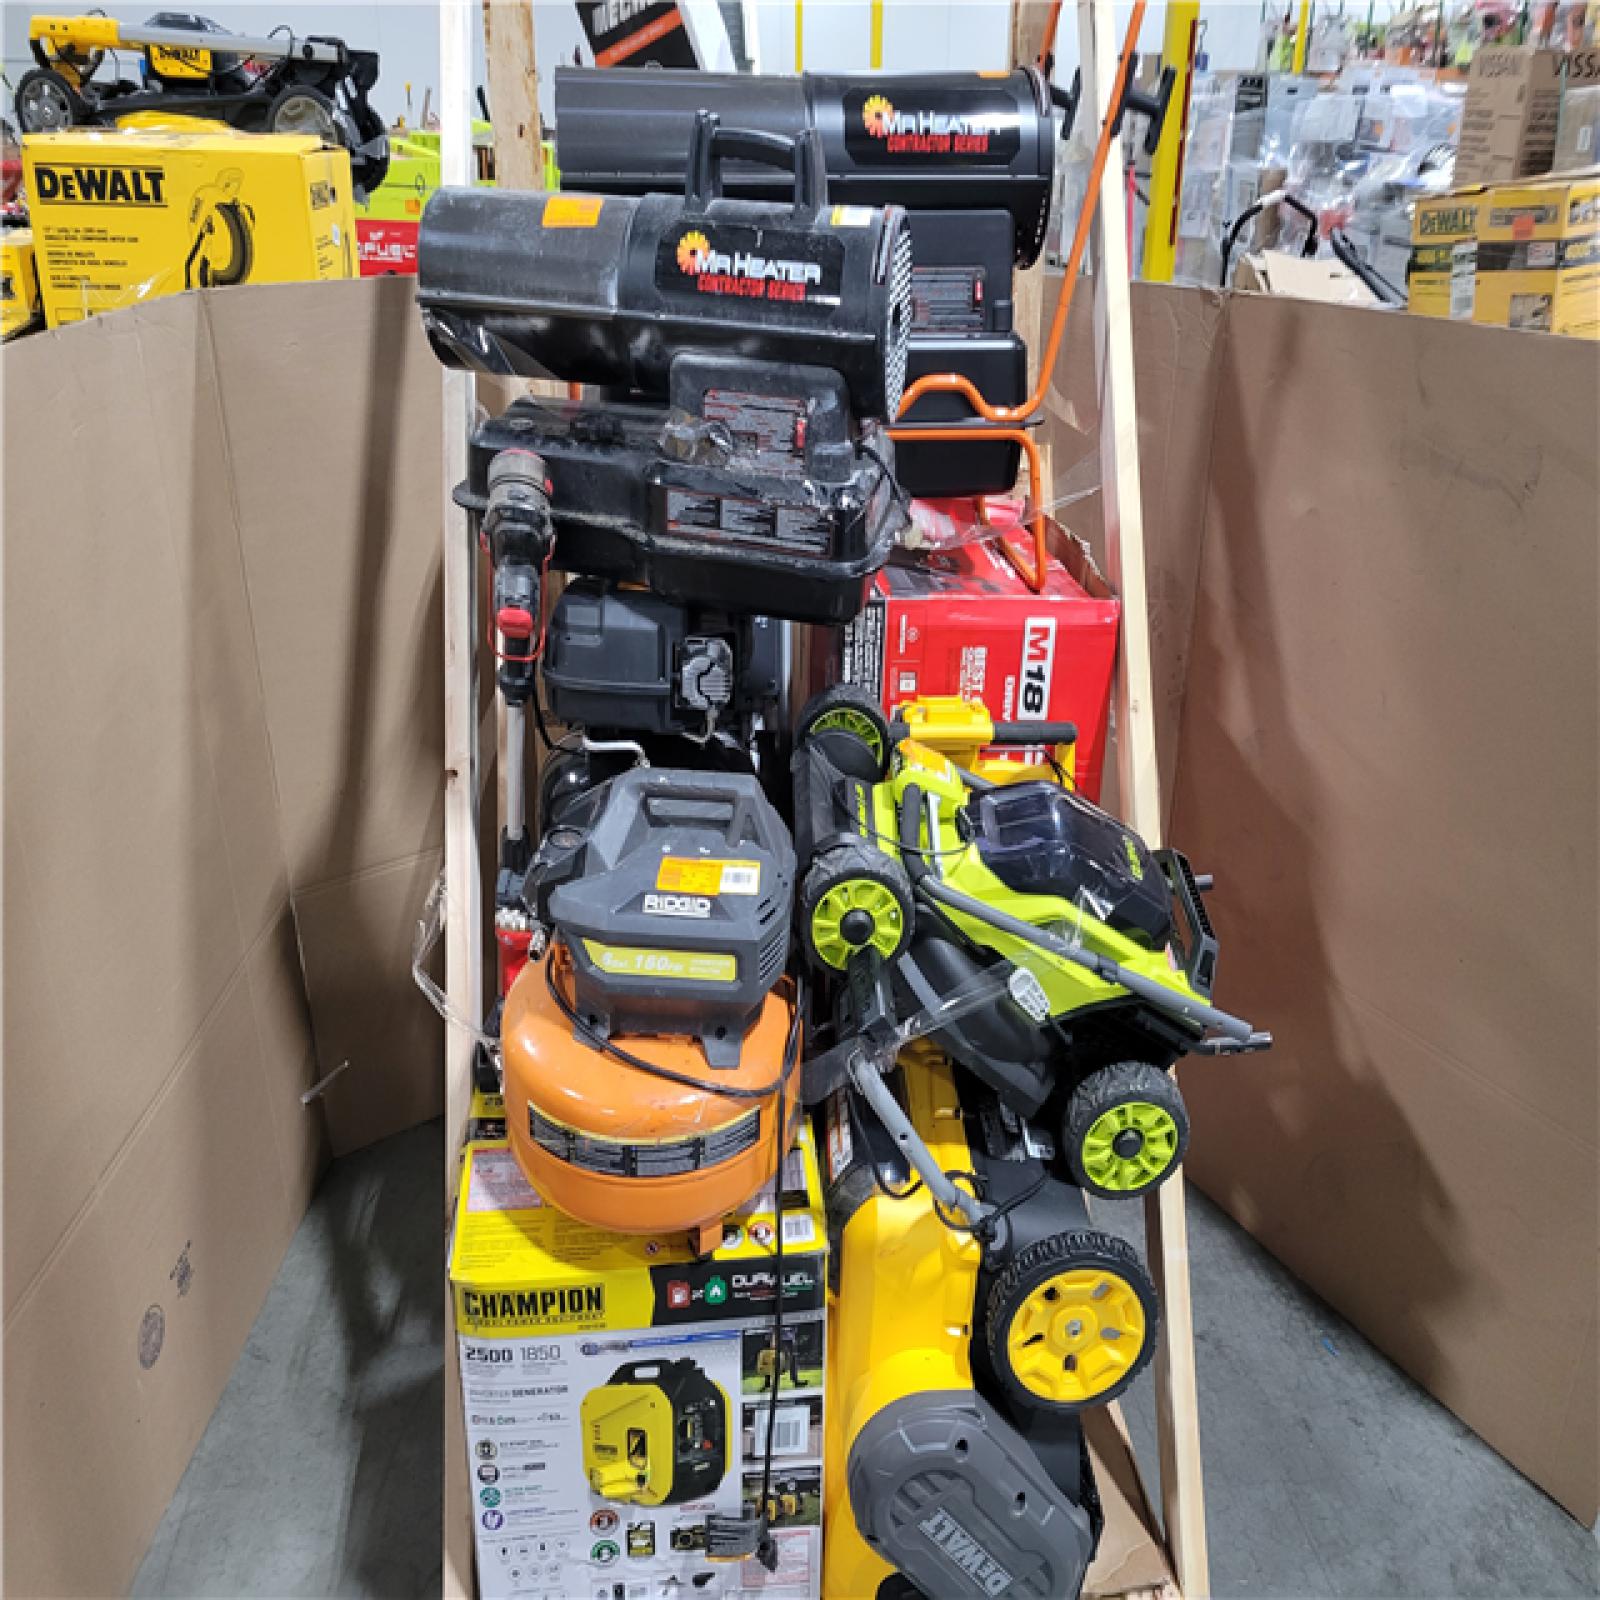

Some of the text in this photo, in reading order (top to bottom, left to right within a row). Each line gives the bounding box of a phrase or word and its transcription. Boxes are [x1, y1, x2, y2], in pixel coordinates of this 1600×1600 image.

[644, 895, 710, 918] RIDGID
[464, 1287, 602, 1318] CHAMPION
[465, 1345, 513, 1363] 2500
